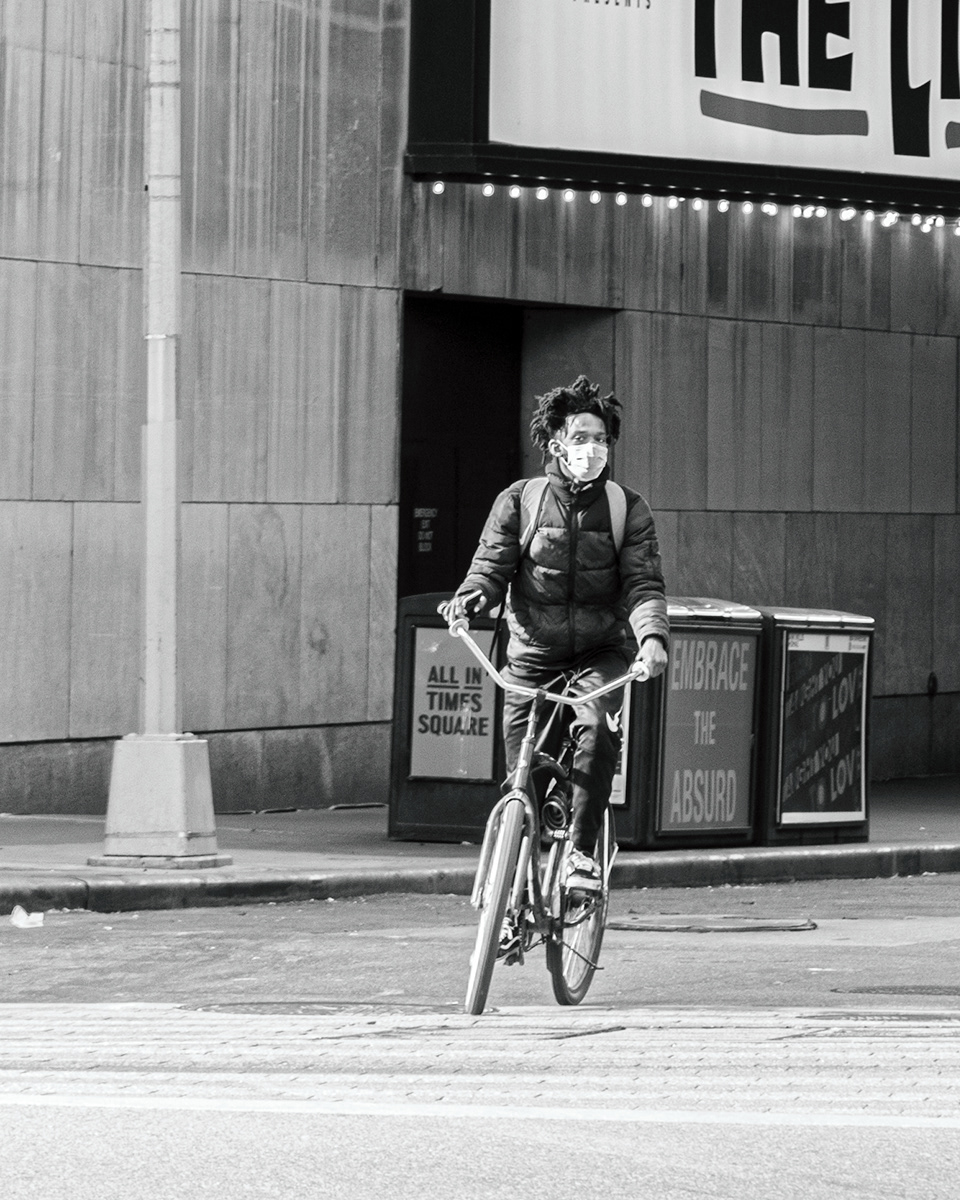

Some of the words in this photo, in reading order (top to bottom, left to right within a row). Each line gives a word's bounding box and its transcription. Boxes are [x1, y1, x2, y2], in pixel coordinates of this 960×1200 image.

[428, 666, 459, 684] ALL
[465, 667, 482, 684] IN
[672, 639, 750, 691] EMBRACE
[427, 691, 482, 712] TIMES
[418, 714, 489, 736] SQUARE
[694, 711, 716, 745] THE
[670, 769, 737, 824] ABSURD
